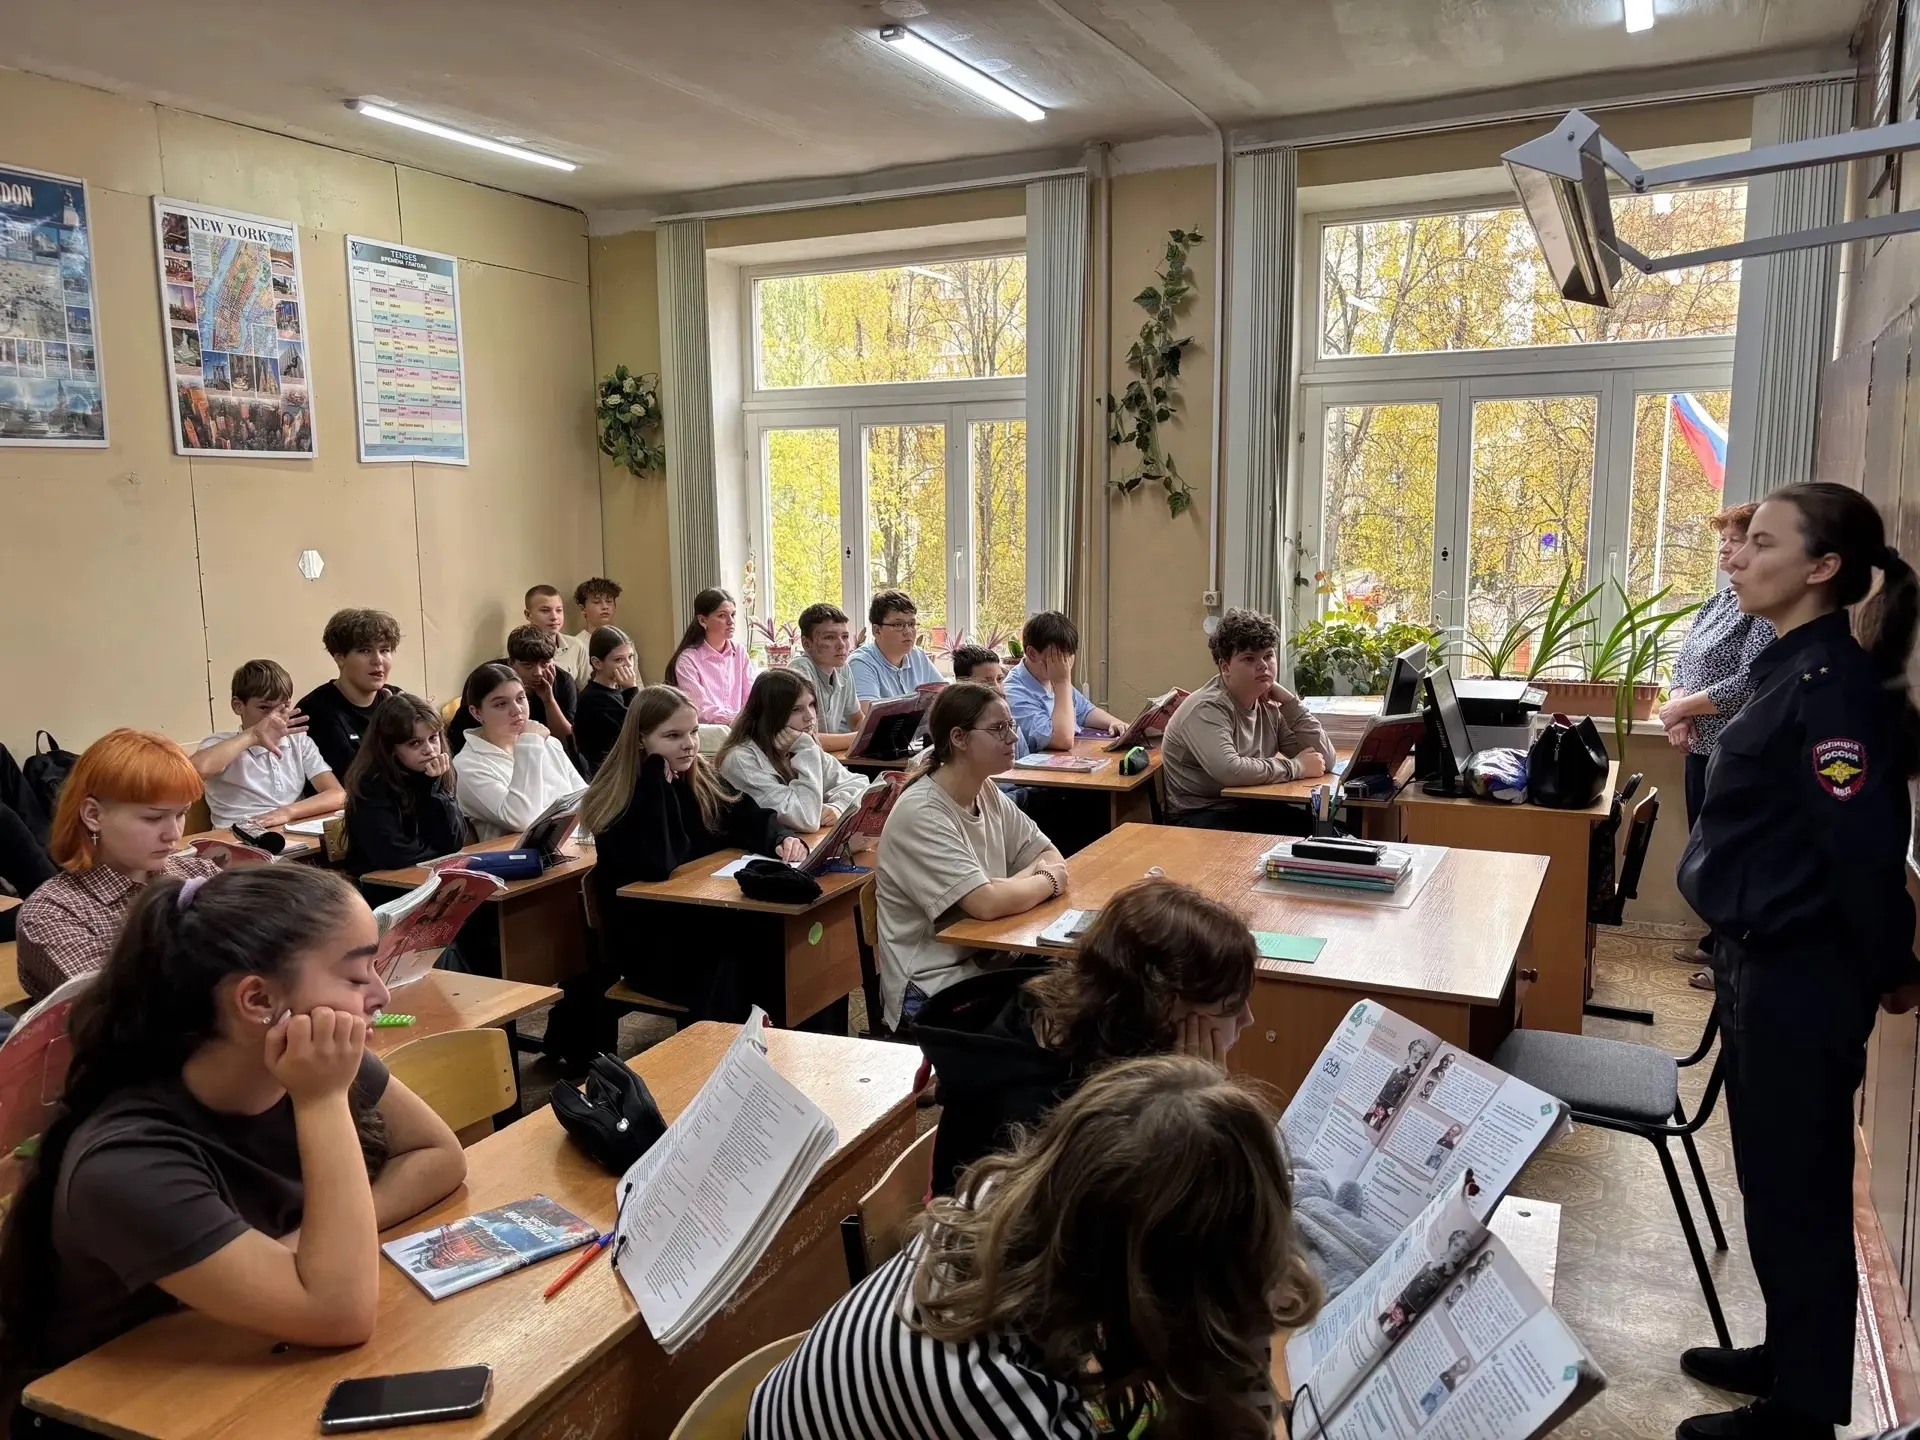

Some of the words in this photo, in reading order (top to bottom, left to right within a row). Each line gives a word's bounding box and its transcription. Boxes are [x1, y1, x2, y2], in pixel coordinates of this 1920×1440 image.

[189, 216, 224, 233] NEW
[227, 223, 269, 242] YORK
[391, 250, 417, 261] TENSES
[380, 256, 404, 265] ВРЕМЕНА
[405, 261, 427, 269] ГЛАГОЛА
[1816, 741, 1859, 754] ПОЛИЦИЯ
[1820, 750, 1859, 764] РОССИЯ
[1832, 786, 1852, 797] МВД
[502, 1210, 556, 1243] АНГЛИЙСКИЙ
